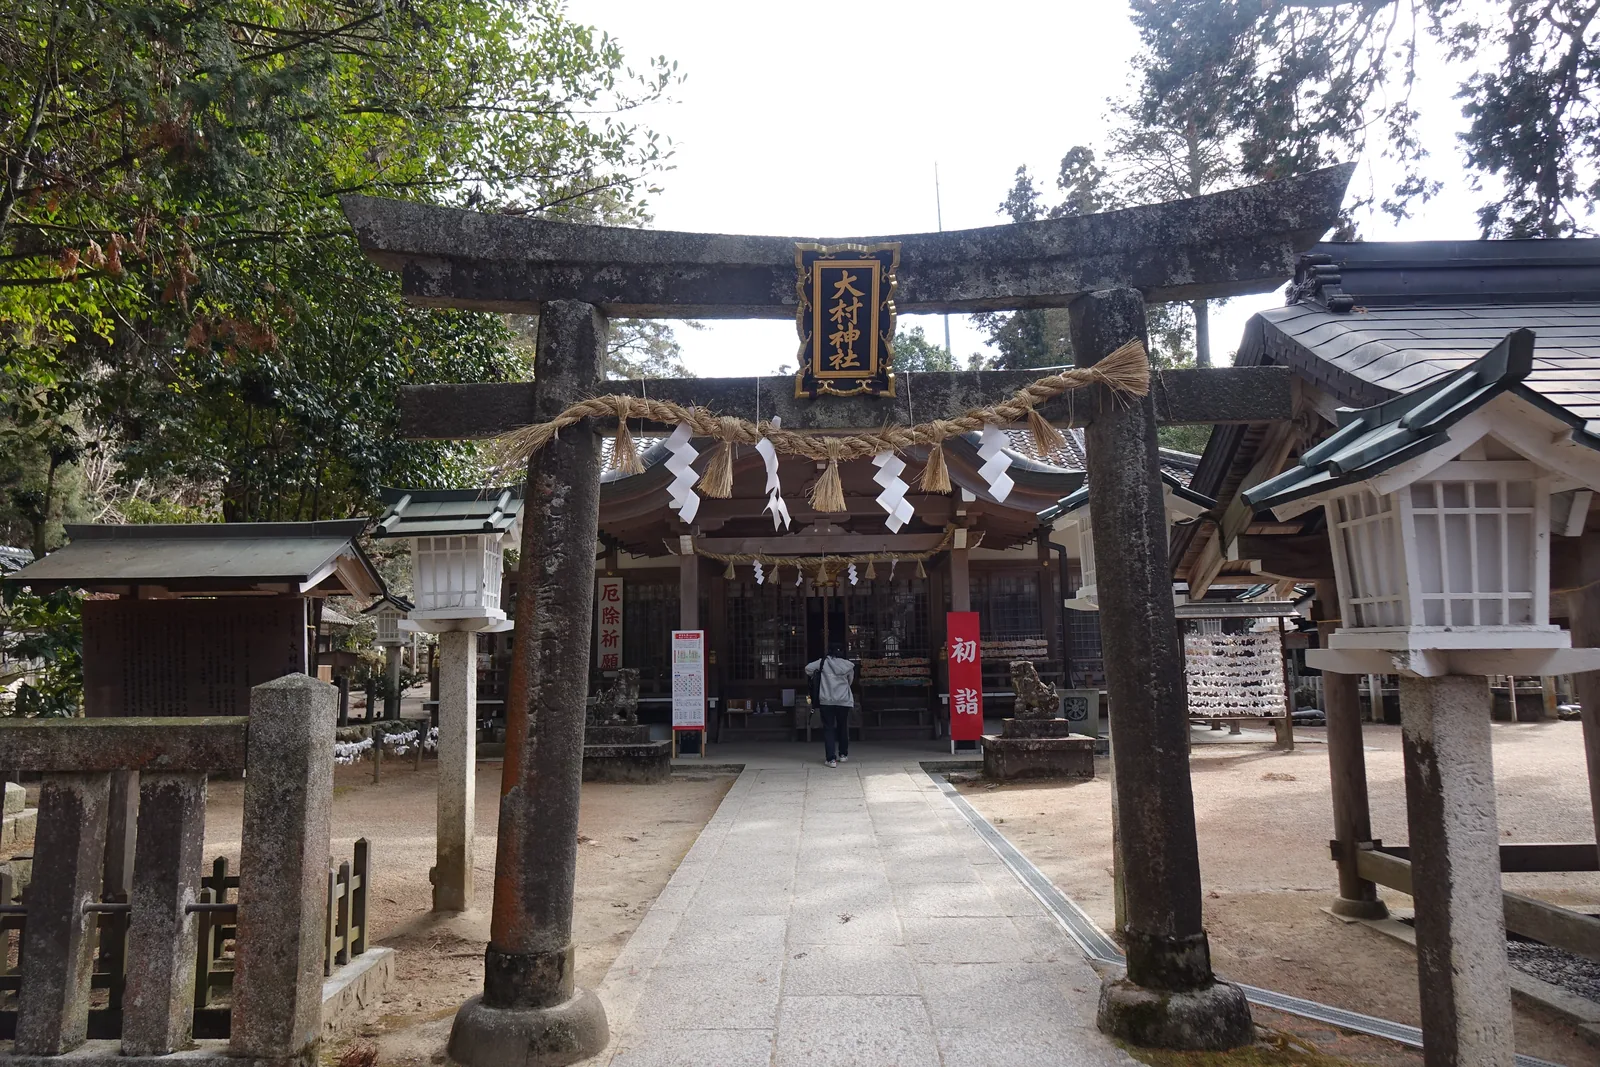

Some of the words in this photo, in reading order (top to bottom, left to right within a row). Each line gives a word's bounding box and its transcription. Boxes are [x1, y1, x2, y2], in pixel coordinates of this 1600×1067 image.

[829, 270, 865, 370] 大村神社
[600, 583, 621, 671] 厄除祈願
[950, 636, 979, 716] 初詣
